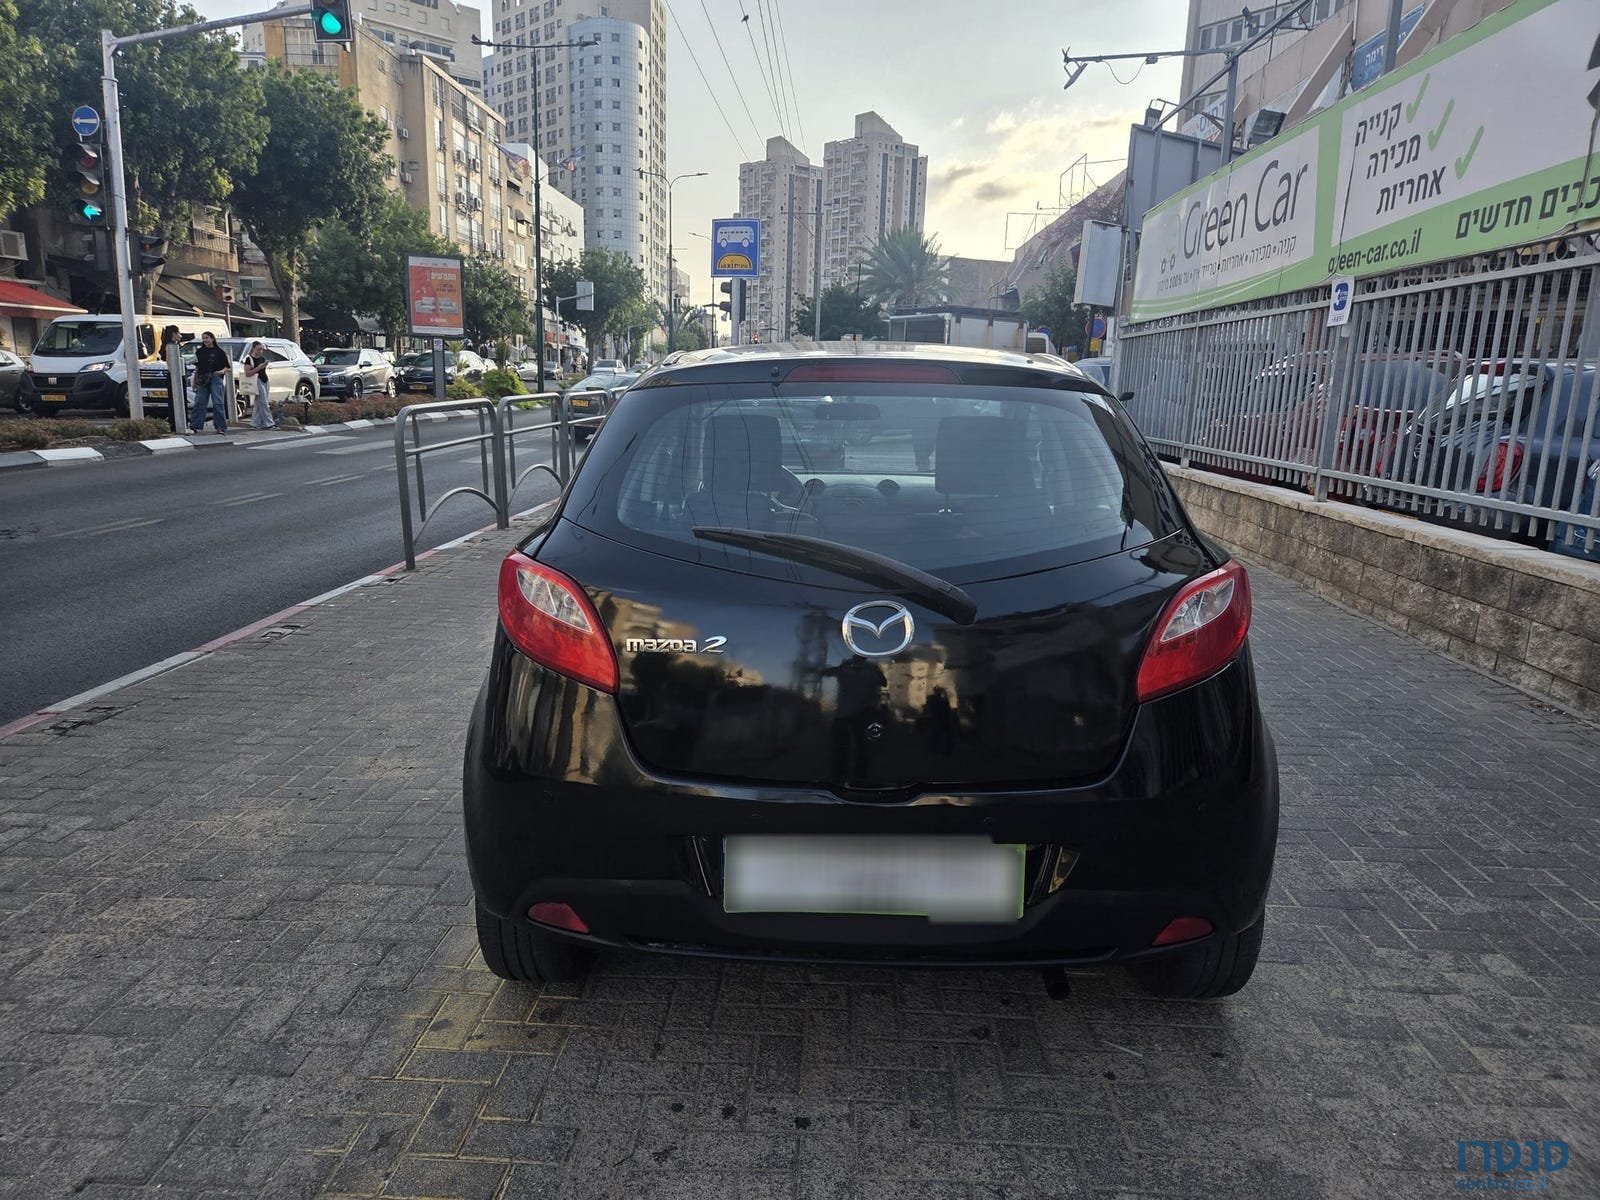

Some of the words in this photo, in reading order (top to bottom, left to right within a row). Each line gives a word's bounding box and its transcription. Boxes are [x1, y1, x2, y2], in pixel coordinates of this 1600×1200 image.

[1355, 102, 1402, 147] קנייה
[1366, 134, 1421, 180] מכירה
[1184, 192, 1248, 259] Green
[1254, 159, 1309, 232] Car
[1376, 165, 1446, 215] אחריות
[1455, 195, 1532, 240] חדשים
[626, 637, 697, 653] mazda
[700, 636, 729, 653] 2
